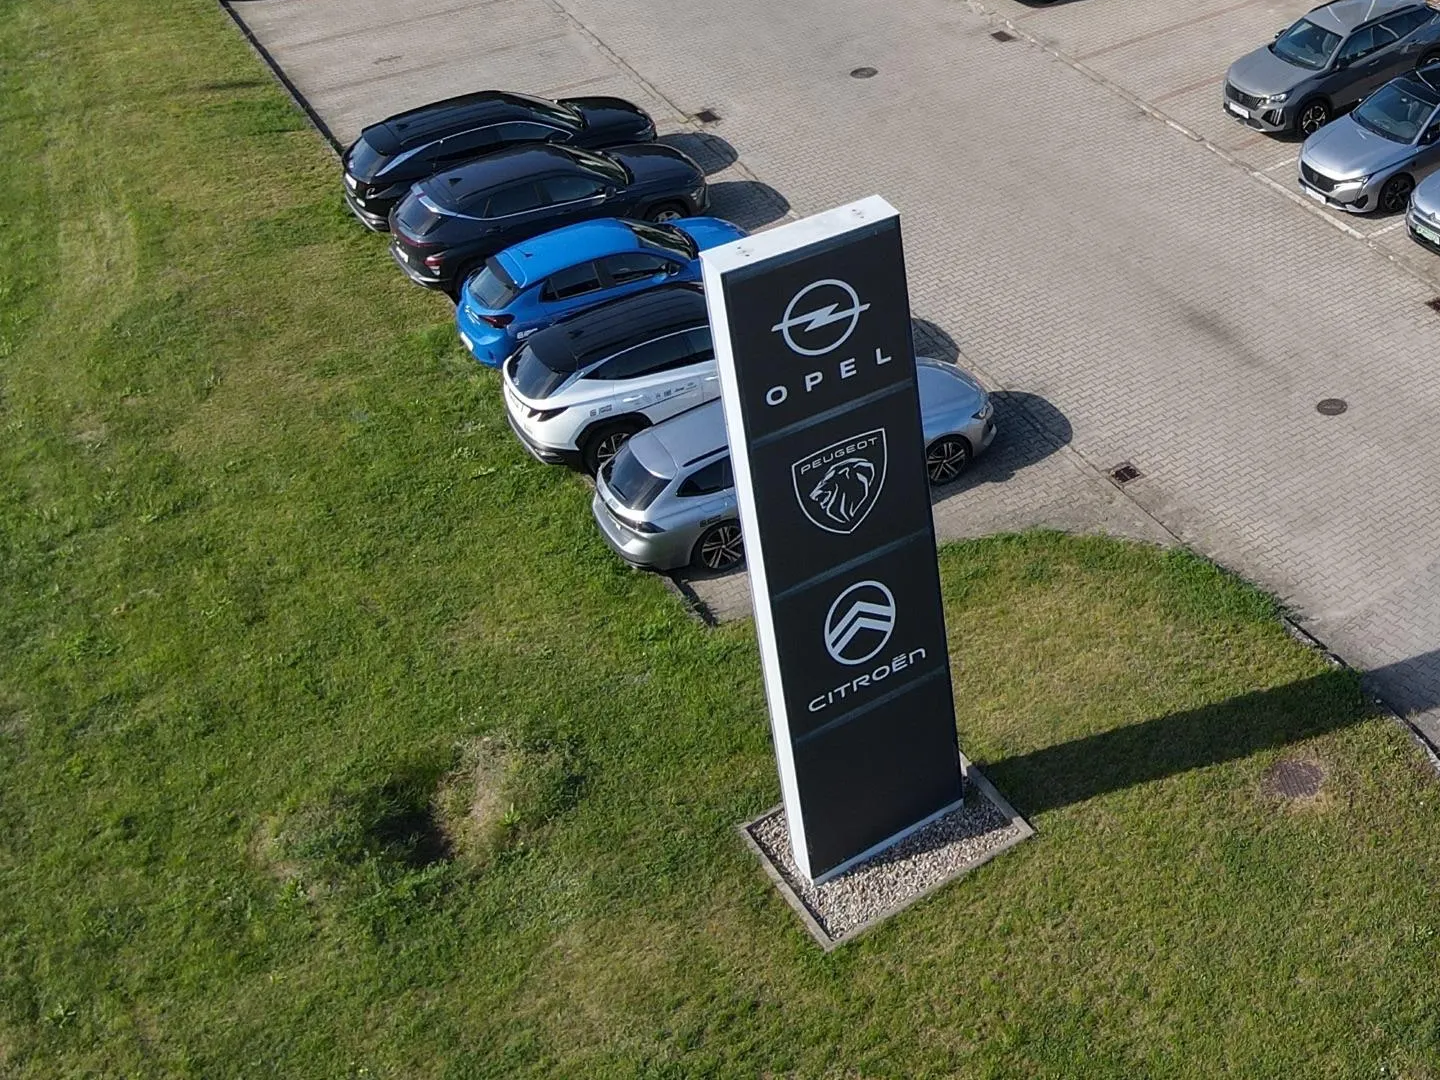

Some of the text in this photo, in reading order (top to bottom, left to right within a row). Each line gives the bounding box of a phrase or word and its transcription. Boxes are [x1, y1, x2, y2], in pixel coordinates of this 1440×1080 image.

[765, 348, 892, 406] OPEL
[800, 436, 878, 475] PEUGEOT
[807, 647, 927, 713] CITROËN
